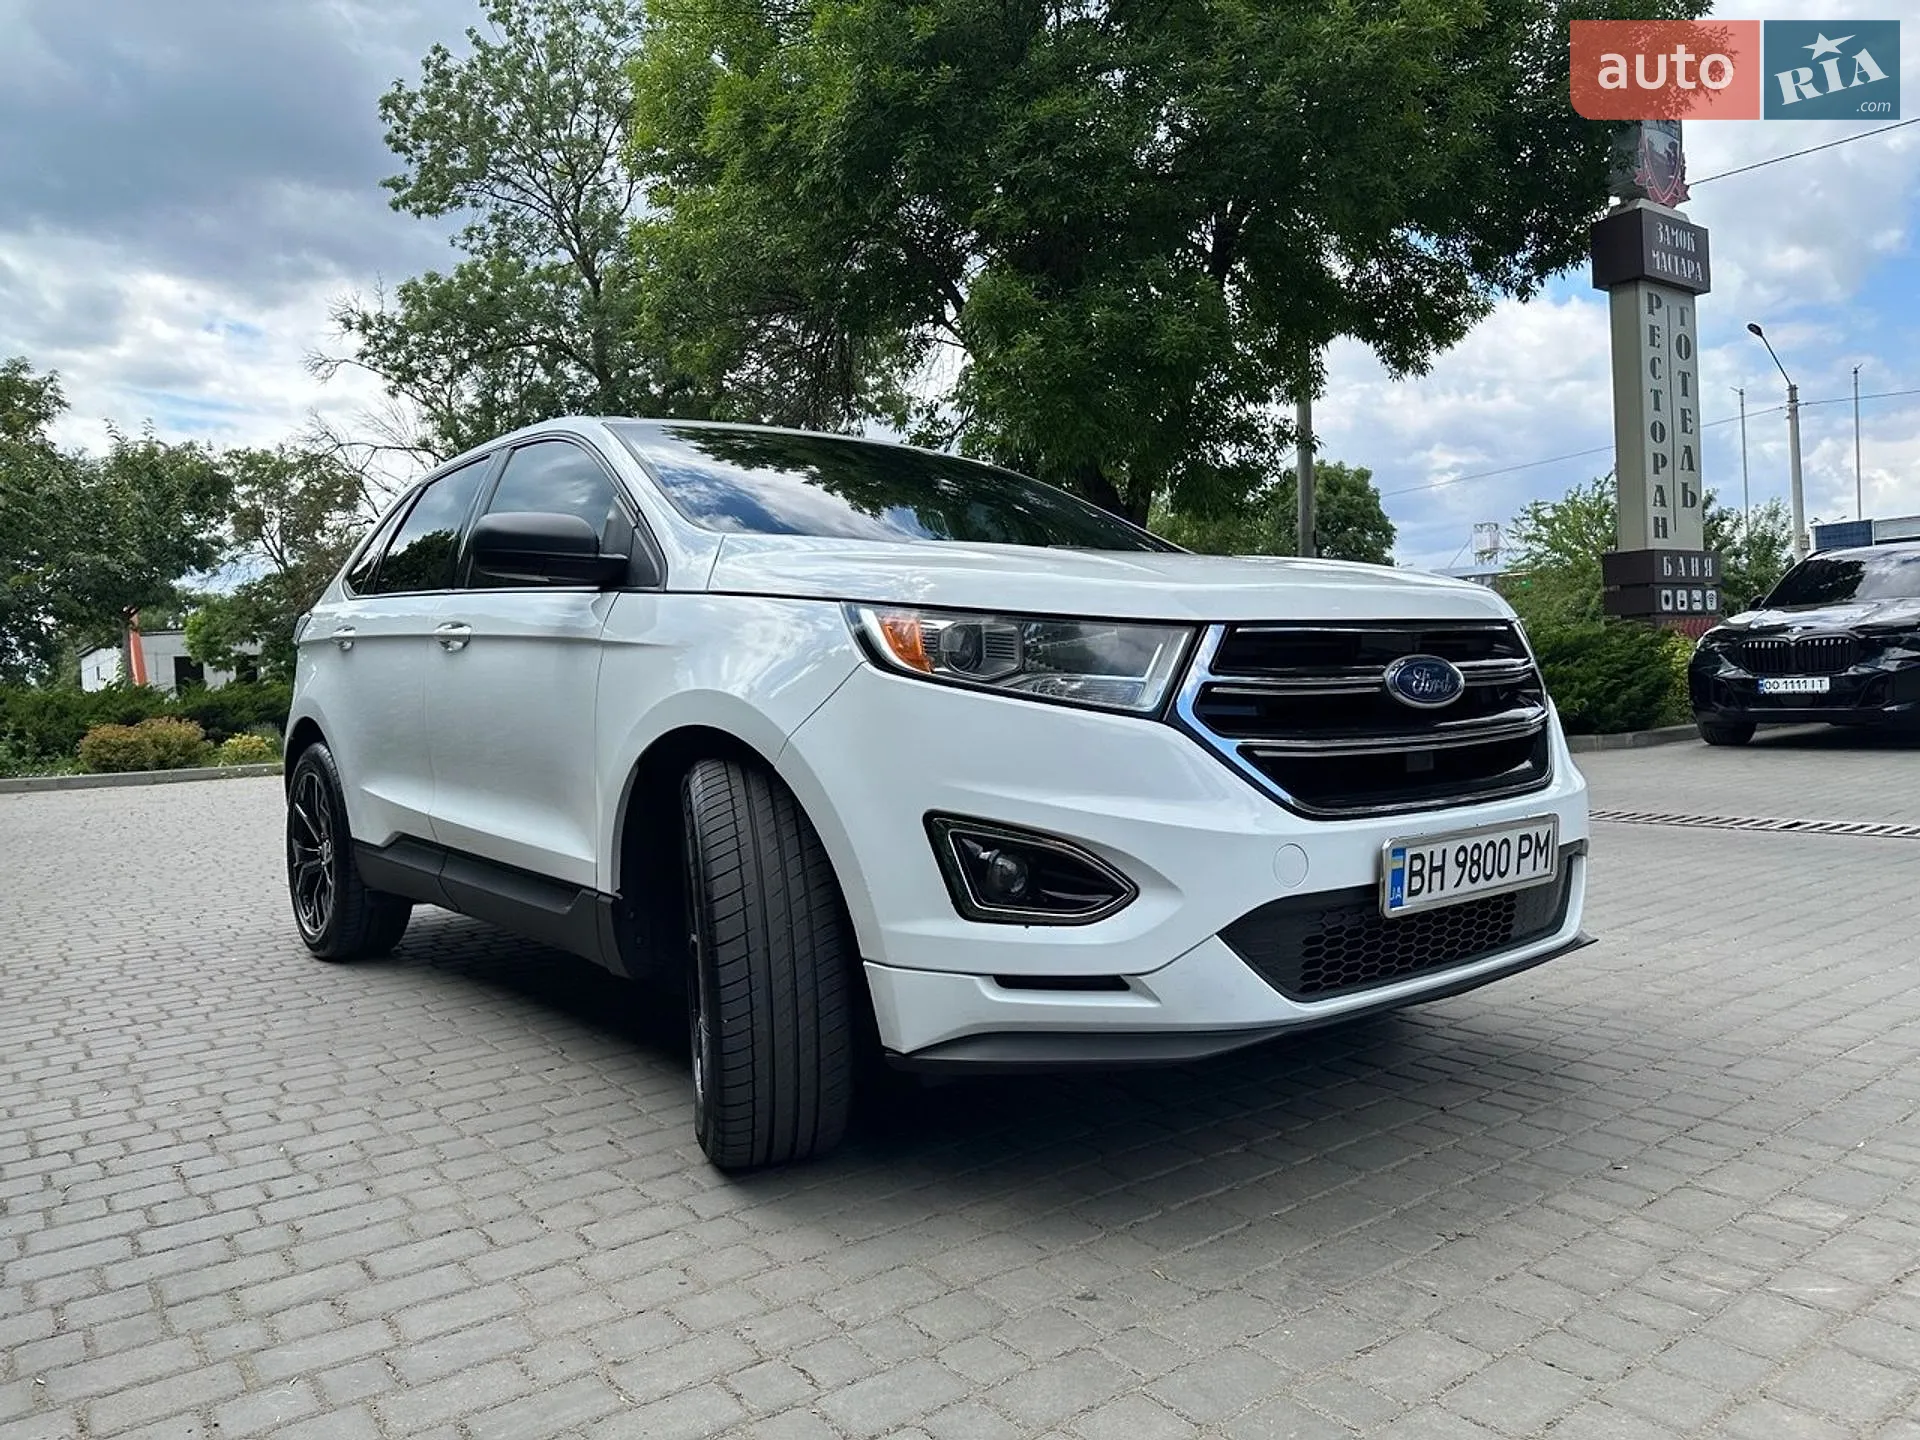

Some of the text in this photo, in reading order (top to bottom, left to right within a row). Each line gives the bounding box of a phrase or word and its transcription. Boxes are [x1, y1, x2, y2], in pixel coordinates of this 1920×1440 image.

[1656, 221, 1696, 253] ЗАМОК
[1647, 292, 1669, 539] РЕСТОРАН
[1675, 306, 1698, 508] ГОТЕЛЬ
[1663, 556, 1713, 577] БАНЯ
[1411, 666, 1453, 695] Ford
[1782, 680, 1807, 690] 1111
[1407, 830, 1552, 898] BH 9800 PM
